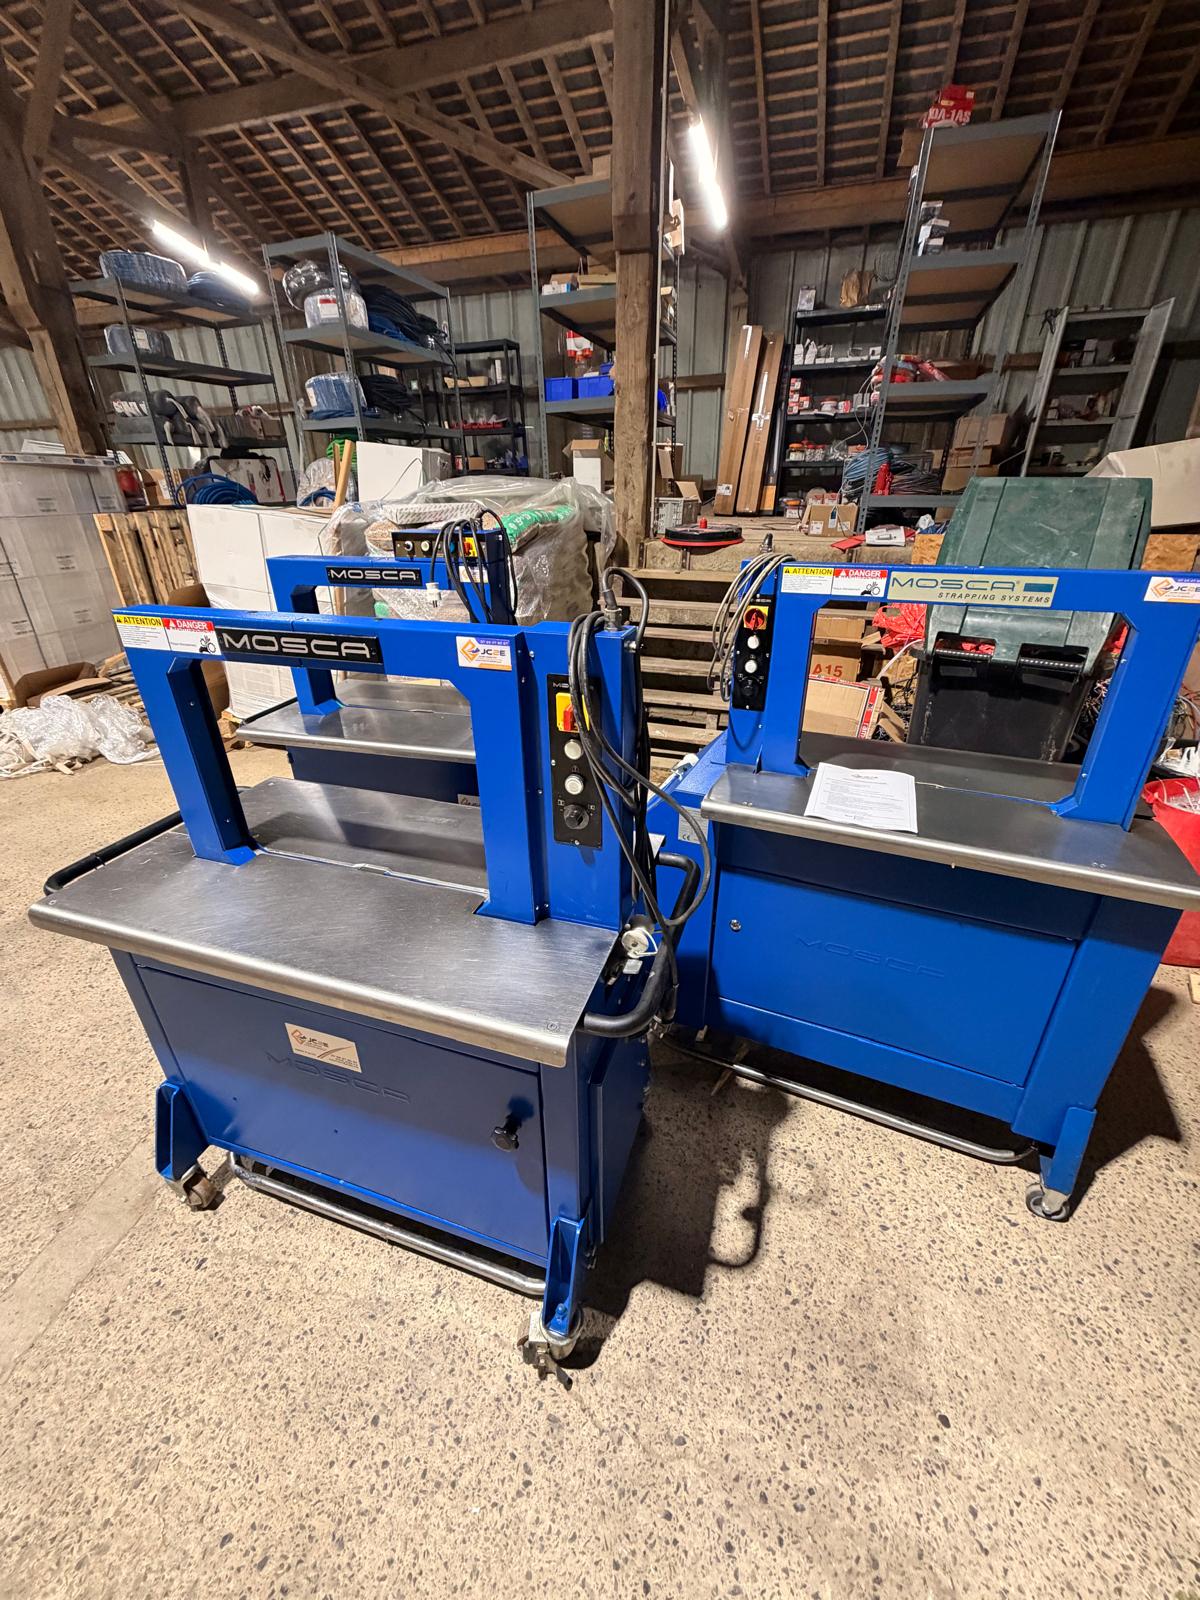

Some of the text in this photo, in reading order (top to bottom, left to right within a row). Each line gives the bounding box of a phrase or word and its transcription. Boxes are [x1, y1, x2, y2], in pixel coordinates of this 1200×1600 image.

[330, 569, 416, 580] MOSCA
[848, 569, 881, 577] DANGER
[892, 577, 1016, 592] MOSCA
[938, 592, 1050, 604] STRAPPING SYSTEMS
[123, 616, 162, 626] ATTENTION
[176, 619, 208, 630] DANGER
[222, 633, 370, 659] MOSCA
